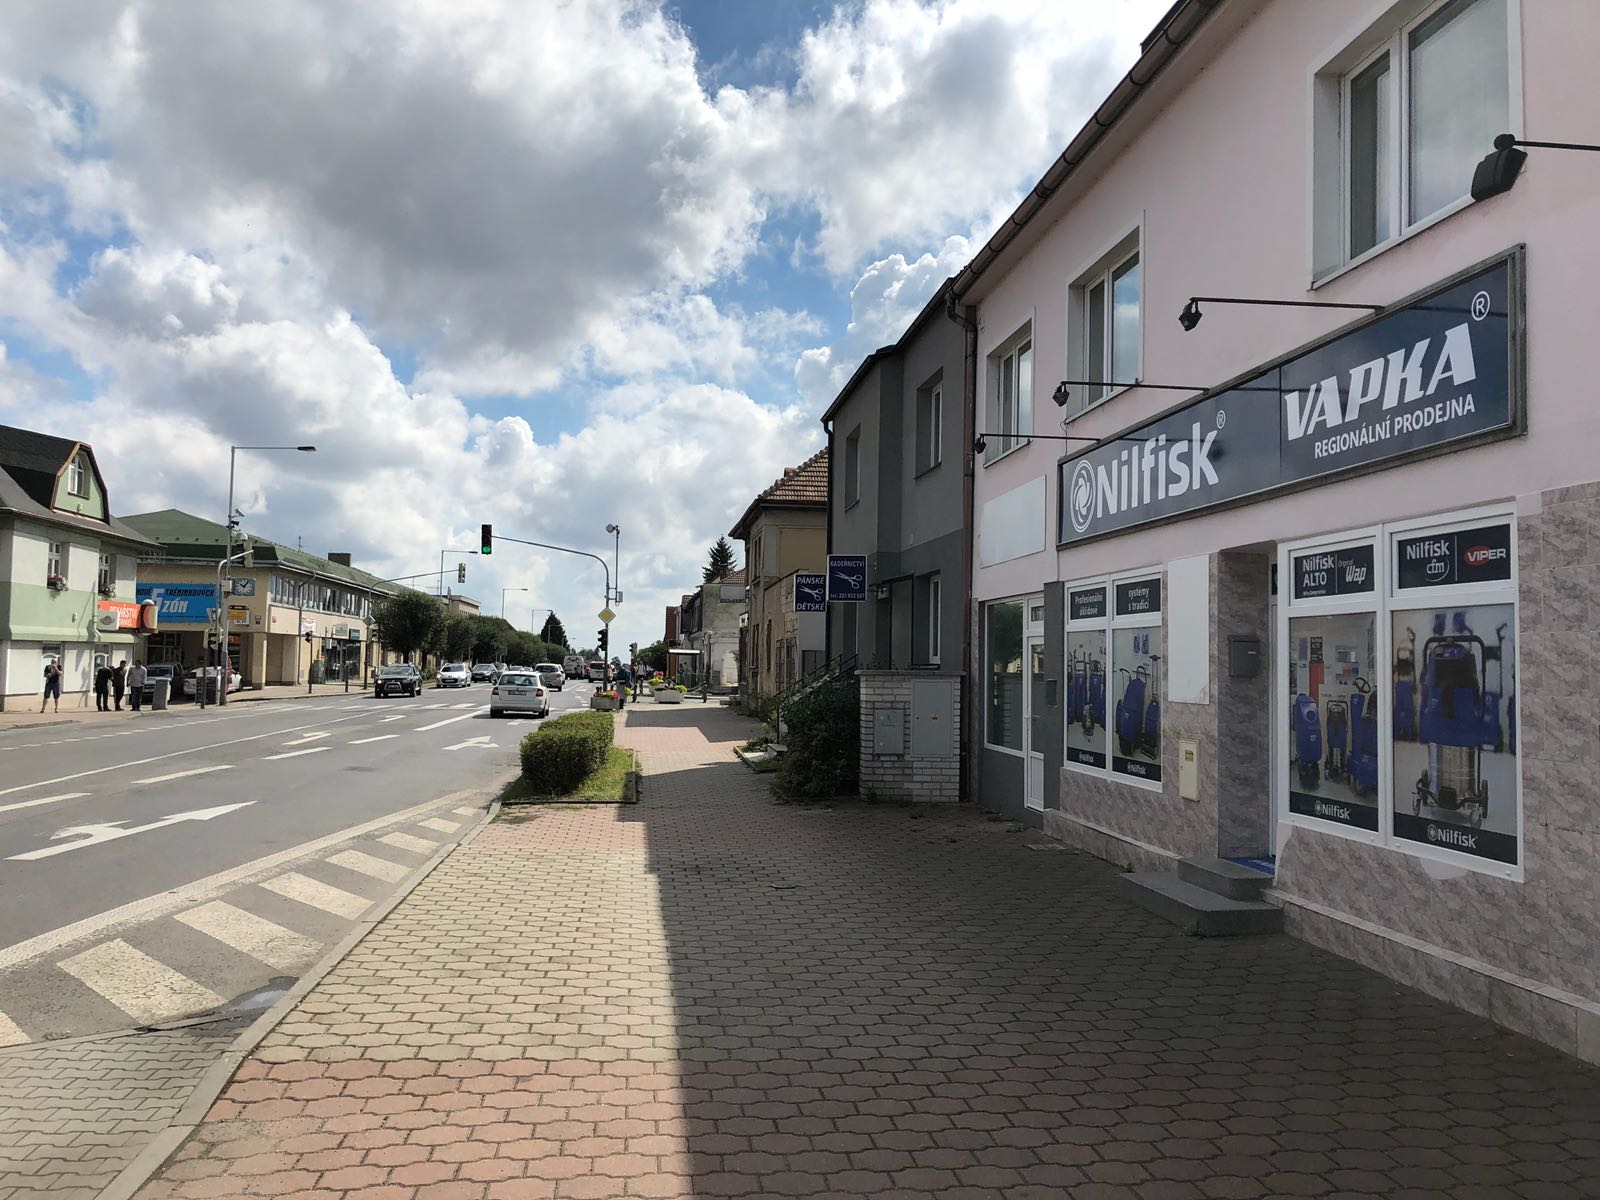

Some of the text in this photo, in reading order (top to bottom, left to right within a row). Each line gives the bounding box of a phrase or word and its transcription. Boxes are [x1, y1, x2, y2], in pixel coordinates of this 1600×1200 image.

[1285, 322, 1476, 441] VAPKA
[1314, 393, 1476, 459] REGIONÁLNÍ PRODEJNA
[1096, 421, 1219, 518] Nilfisk
[1406, 540, 1449, 560] Nilfisk
[1466, 549, 1507, 563] VIPER
[1303, 554, 1335, 571] Nilfisk
[1426, 559, 1445, 574] cfm
[797, 576, 825, 585] PÁNSKÉ
[1303, 571, 1327, 587] ALTO
[1128, 586, 1150, 600] systémy
[796, 602, 825, 611] DĚTSKÉ
[1132, 599, 1149, 610] tradicí
[1322, 803, 1350, 820] Nilfisk
[1437, 828, 1476, 849] Nilfisk
